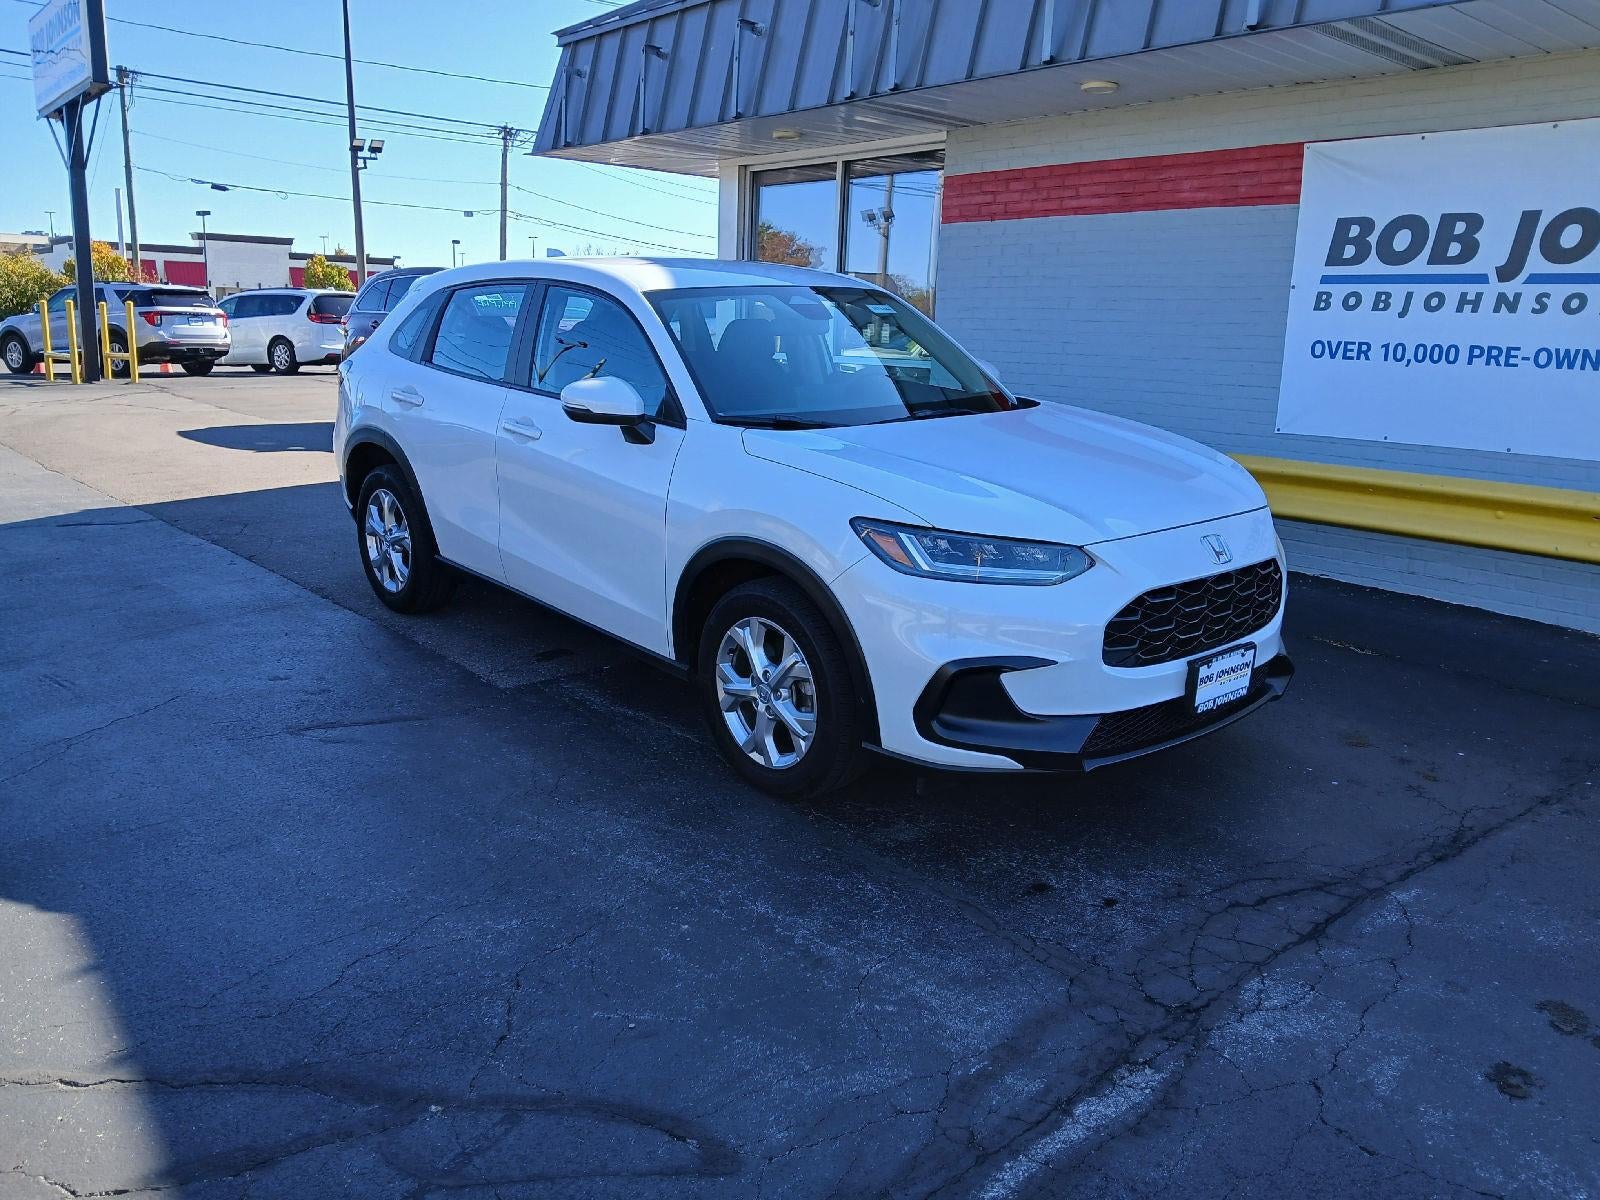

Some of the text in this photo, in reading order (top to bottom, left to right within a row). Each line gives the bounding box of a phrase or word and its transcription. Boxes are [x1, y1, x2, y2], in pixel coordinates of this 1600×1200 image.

[1324, 206, 1600, 283] BOB JO
[1313, 290, 1600, 318] BOBJOHNSO
[1310, 339, 1600, 372] OVER 10,000 PRE-OWN
[1199, 673, 1215, 687] BOB
[1215, 660, 1252, 683] JOHNSON
[1197, 687, 1248, 713] BOB JOHNSON
